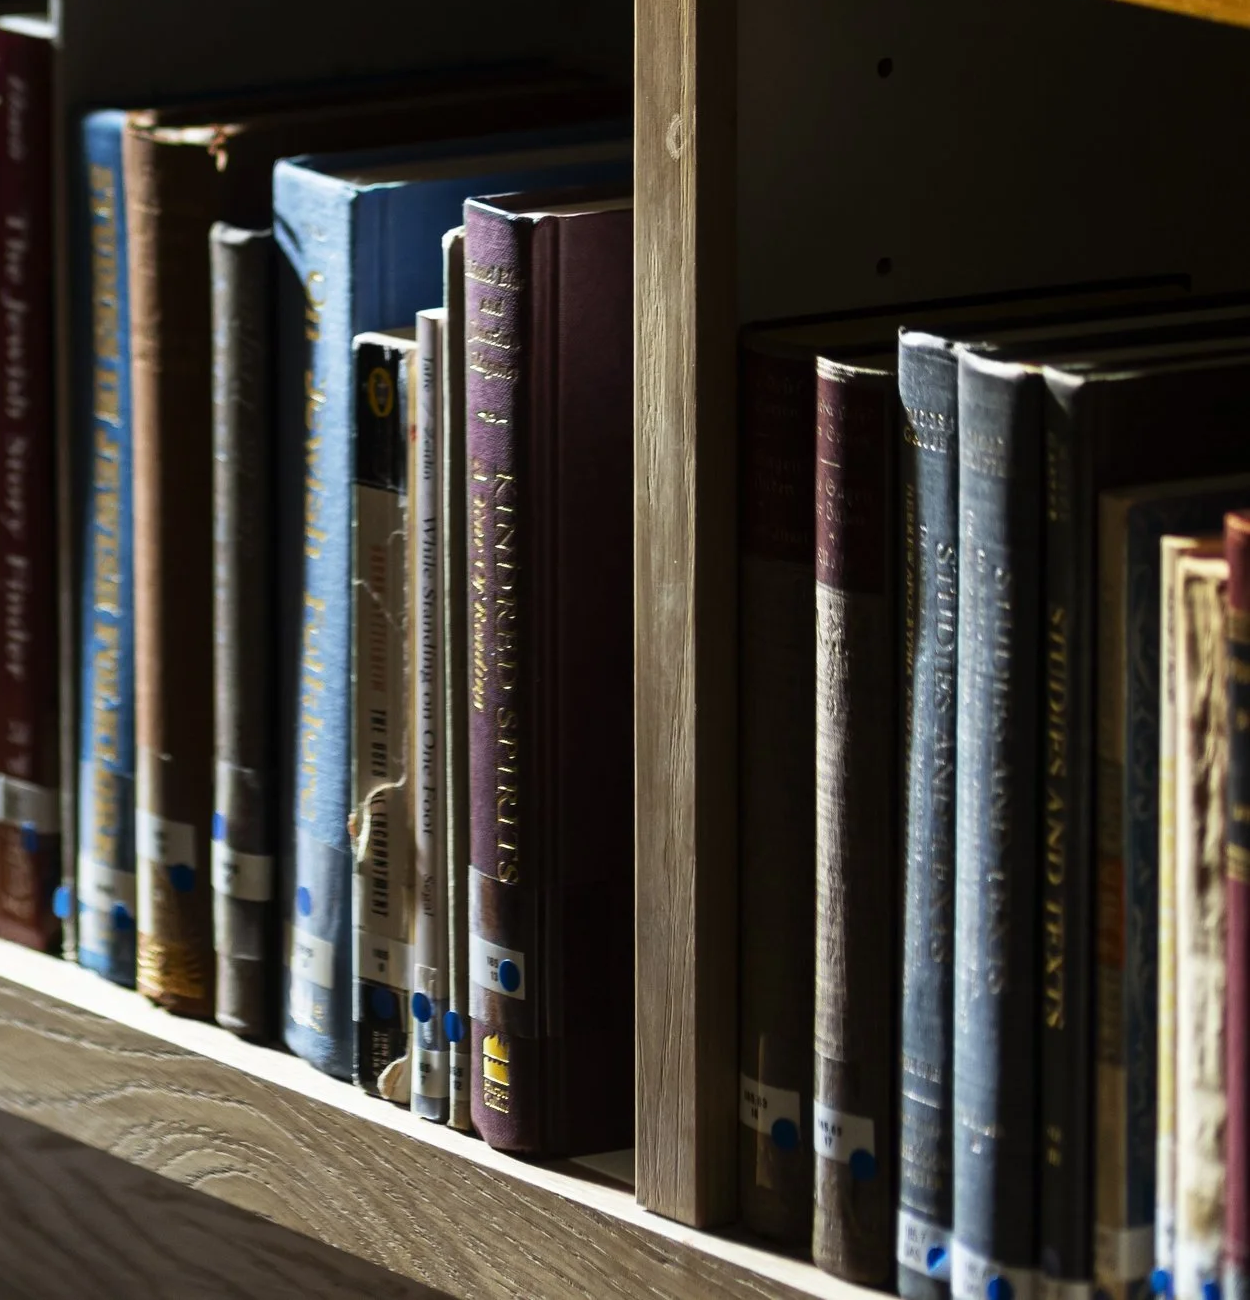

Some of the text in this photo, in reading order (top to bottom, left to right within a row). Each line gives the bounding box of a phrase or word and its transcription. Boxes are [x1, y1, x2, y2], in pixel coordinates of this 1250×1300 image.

[4, 211, 30, 286] The
[0, 288, 32, 420] Jewish
[0, 432, 33, 541] Story
[422, 516, 437, 579] While
[6, 554, 32, 682] Finder
[420, 587, 437, 684] Standing
[935, 541, 957, 714] STUDIES
[370, 708, 388, 736] THE
[423, 691, 436, 720] on
[494, 467, 520, 886] KINDRED SPIRITS
[370, 741, 388, 778] USES
[423, 729, 437, 777] One
[423, 785, 437, 838] Foot
[1045, 605, 1068, 1031] STUDIES AND TEXTS
[371, 812, 389, 918] ENCHANTMENT
